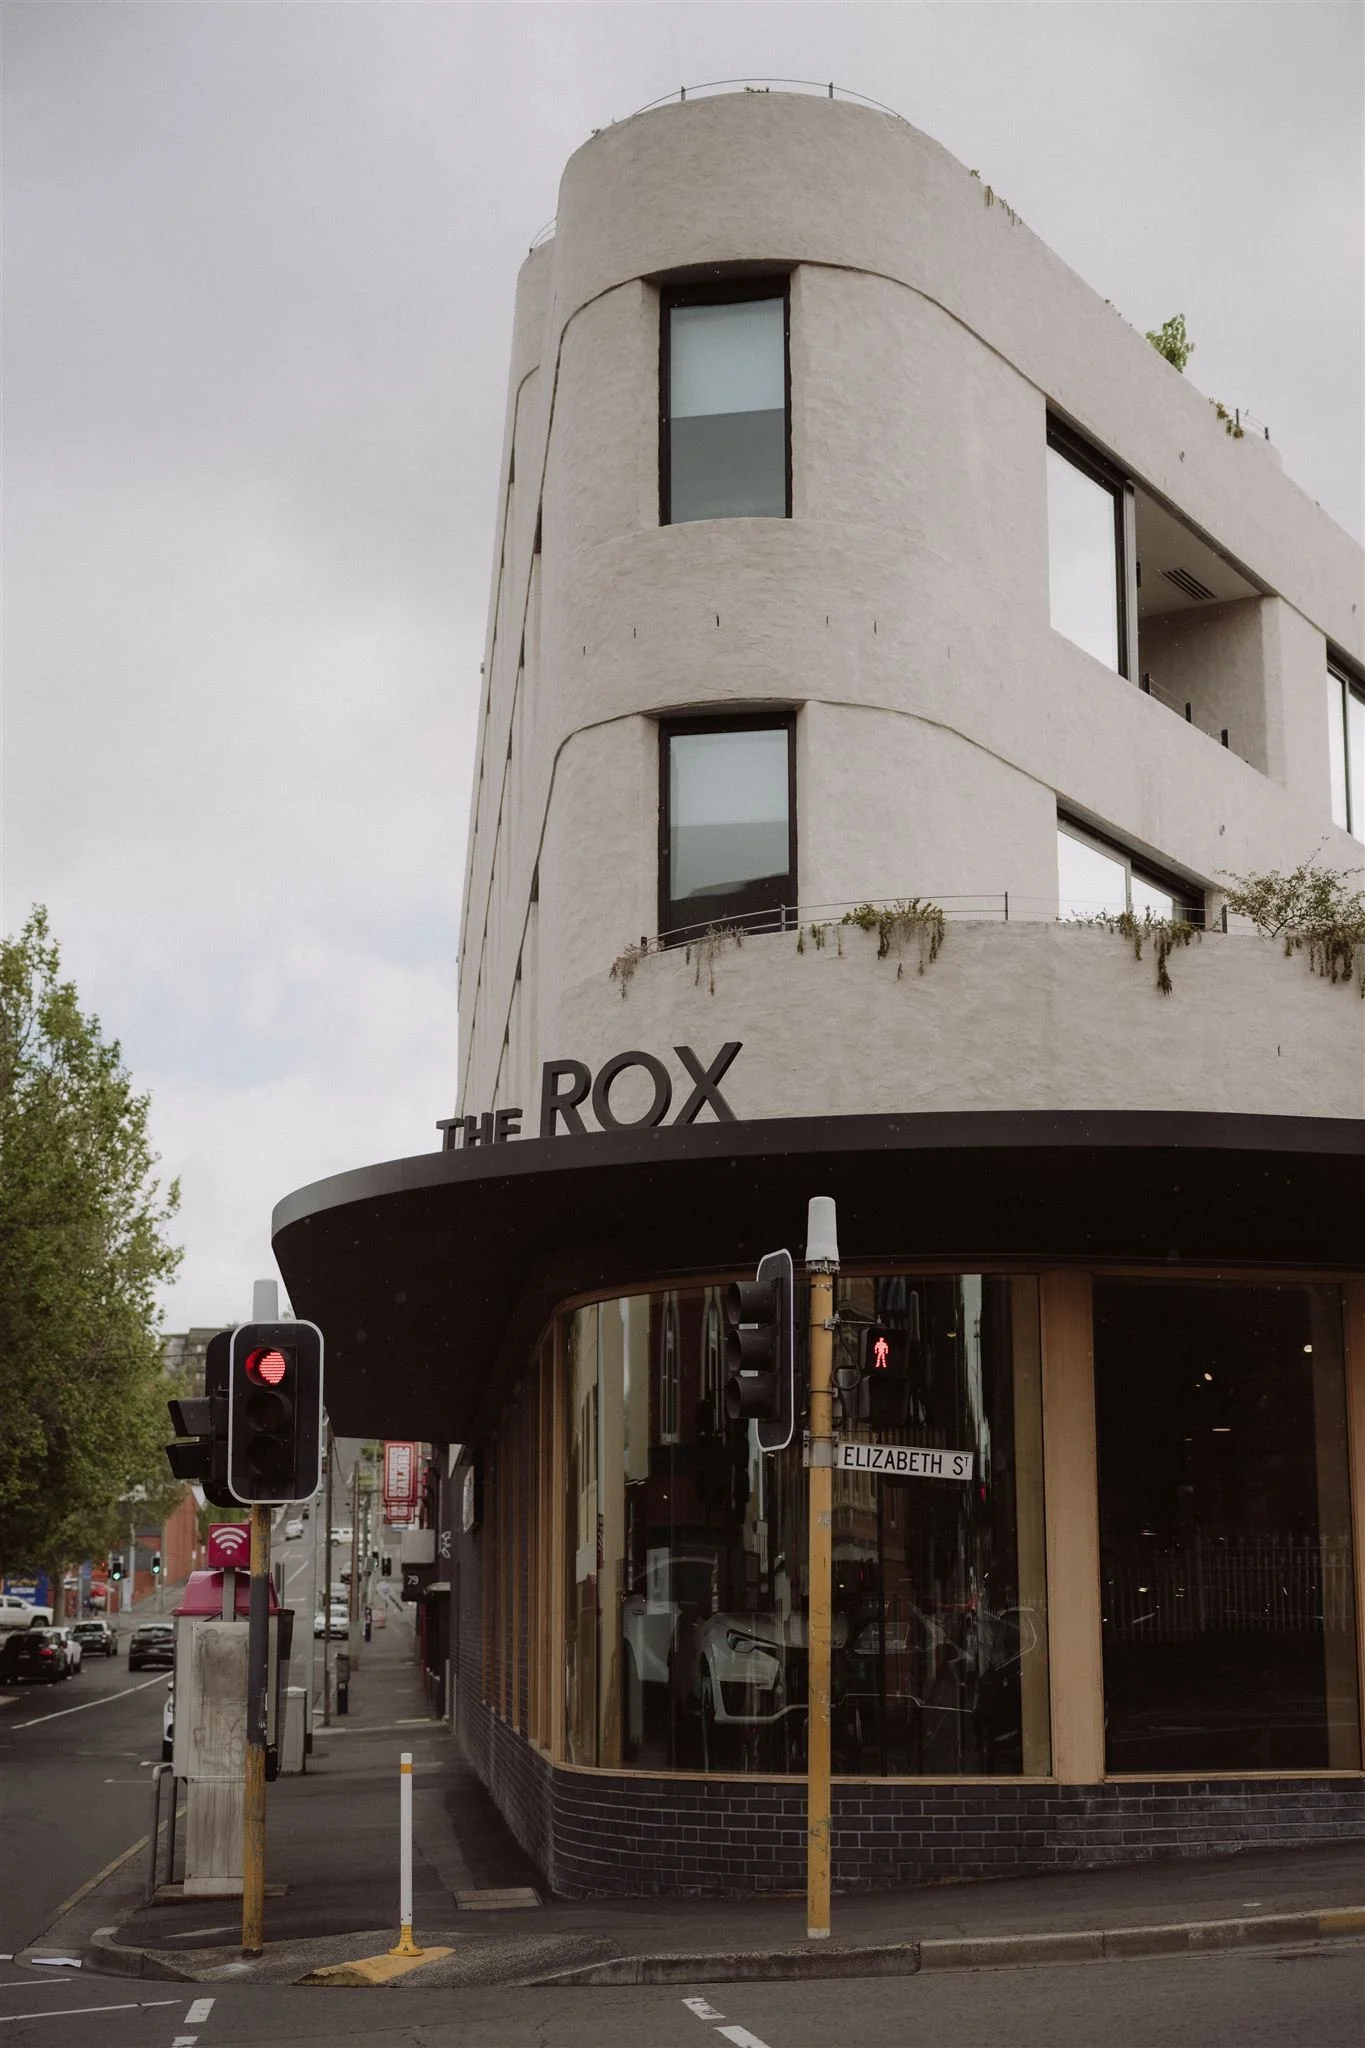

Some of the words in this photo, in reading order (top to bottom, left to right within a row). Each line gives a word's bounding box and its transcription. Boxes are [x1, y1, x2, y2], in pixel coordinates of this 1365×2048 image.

[436, 1108, 523, 1151] THE
[540, 1042, 743, 1138] ROX
[844, 1447, 942, 1474] ELIZABETH
[407, 1575, 420, 1585] 79
